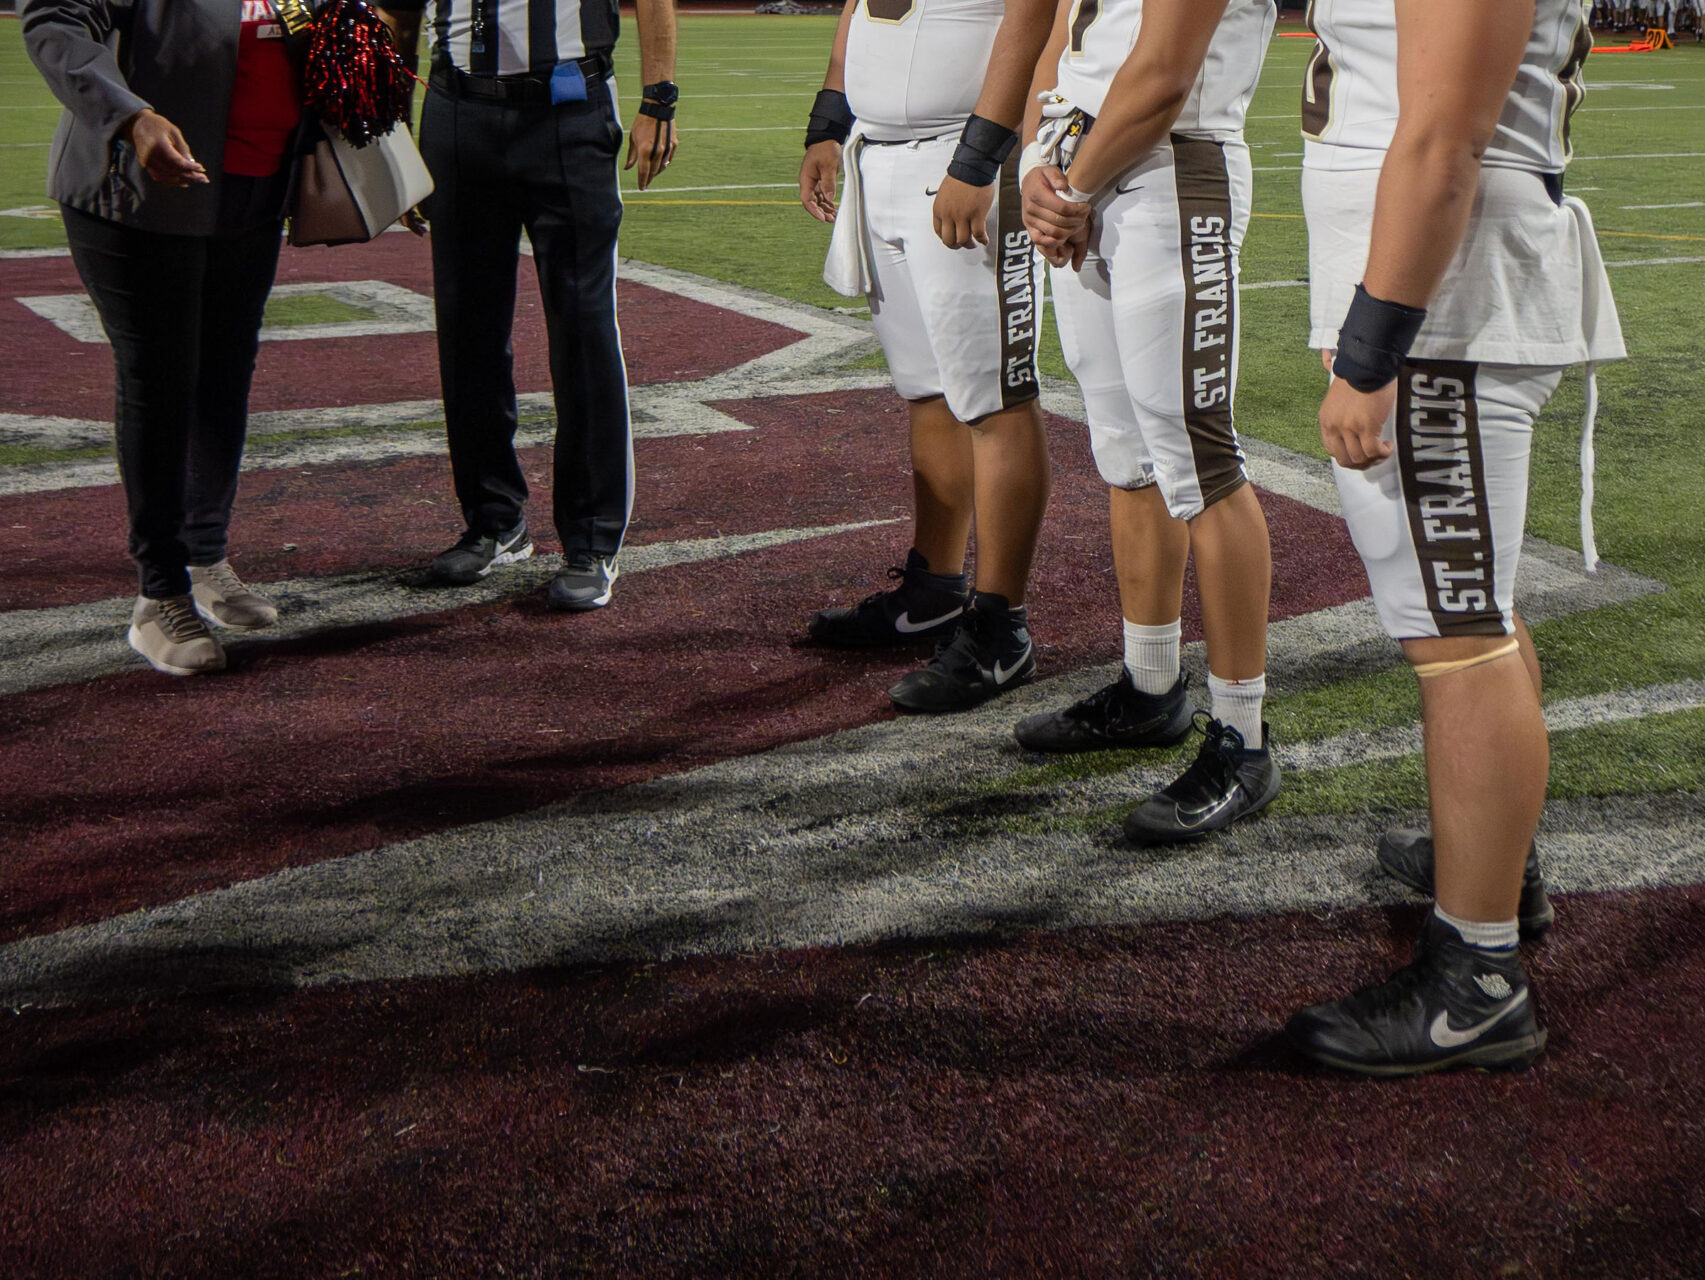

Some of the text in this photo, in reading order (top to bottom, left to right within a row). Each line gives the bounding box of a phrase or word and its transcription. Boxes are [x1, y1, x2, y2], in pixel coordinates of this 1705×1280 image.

[1647, 31, 1661, 49] 20
[1003, 230, 1033, 389] ST. FRANCIS
[1190, 215, 1228, 409] ST. FRANCIS
[1410, 373, 1487, 613] ST. FRANCIS
